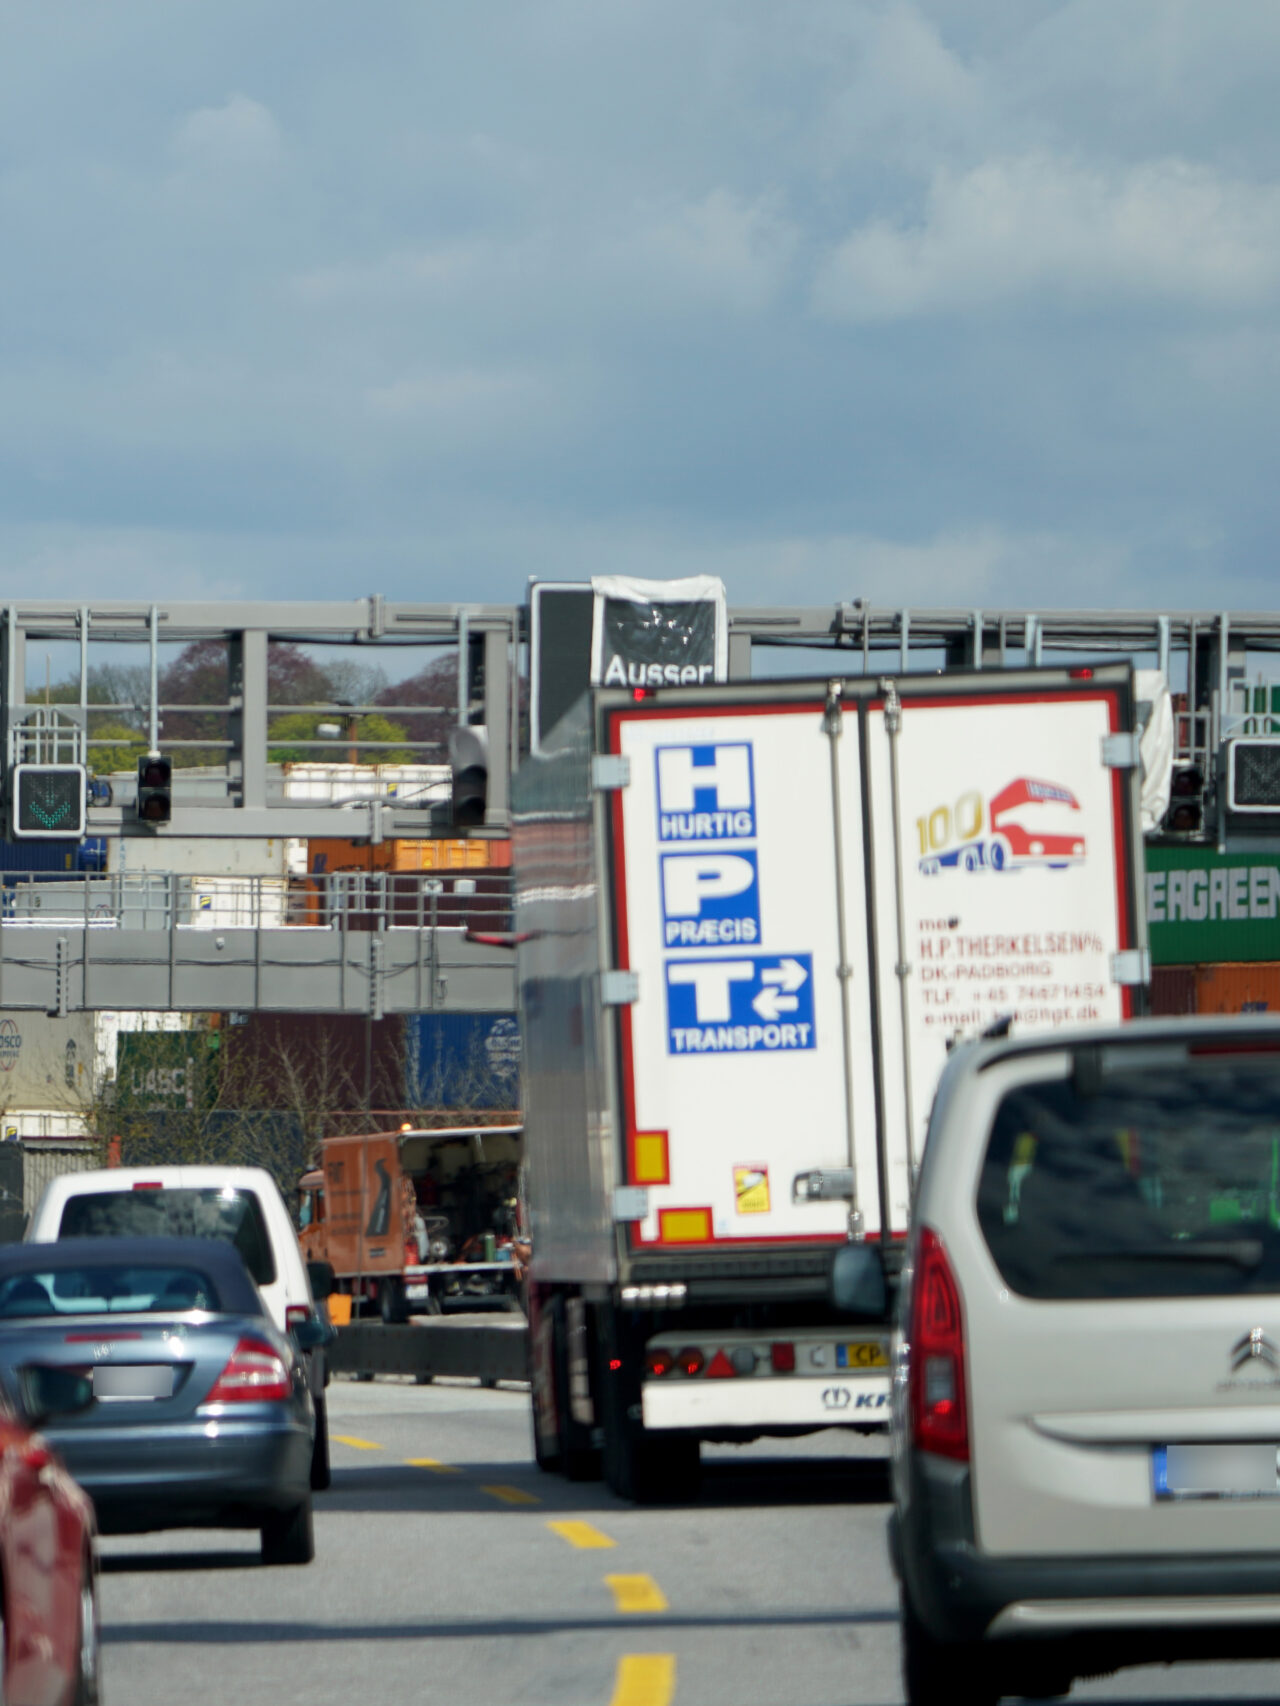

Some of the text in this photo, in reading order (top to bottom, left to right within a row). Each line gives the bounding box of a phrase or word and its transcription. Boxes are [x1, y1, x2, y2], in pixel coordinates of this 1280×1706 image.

[604, 654, 714, 686] Ausser
[657, 744, 751, 812] H
[660, 810, 753, 839] HURTIG
[663, 854, 754, 917] P
[665, 917, 757, 945] PRÆCIS
[668, 960, 755, 1024] T
[671, 1022, 812, 1051] TRANSPORT
